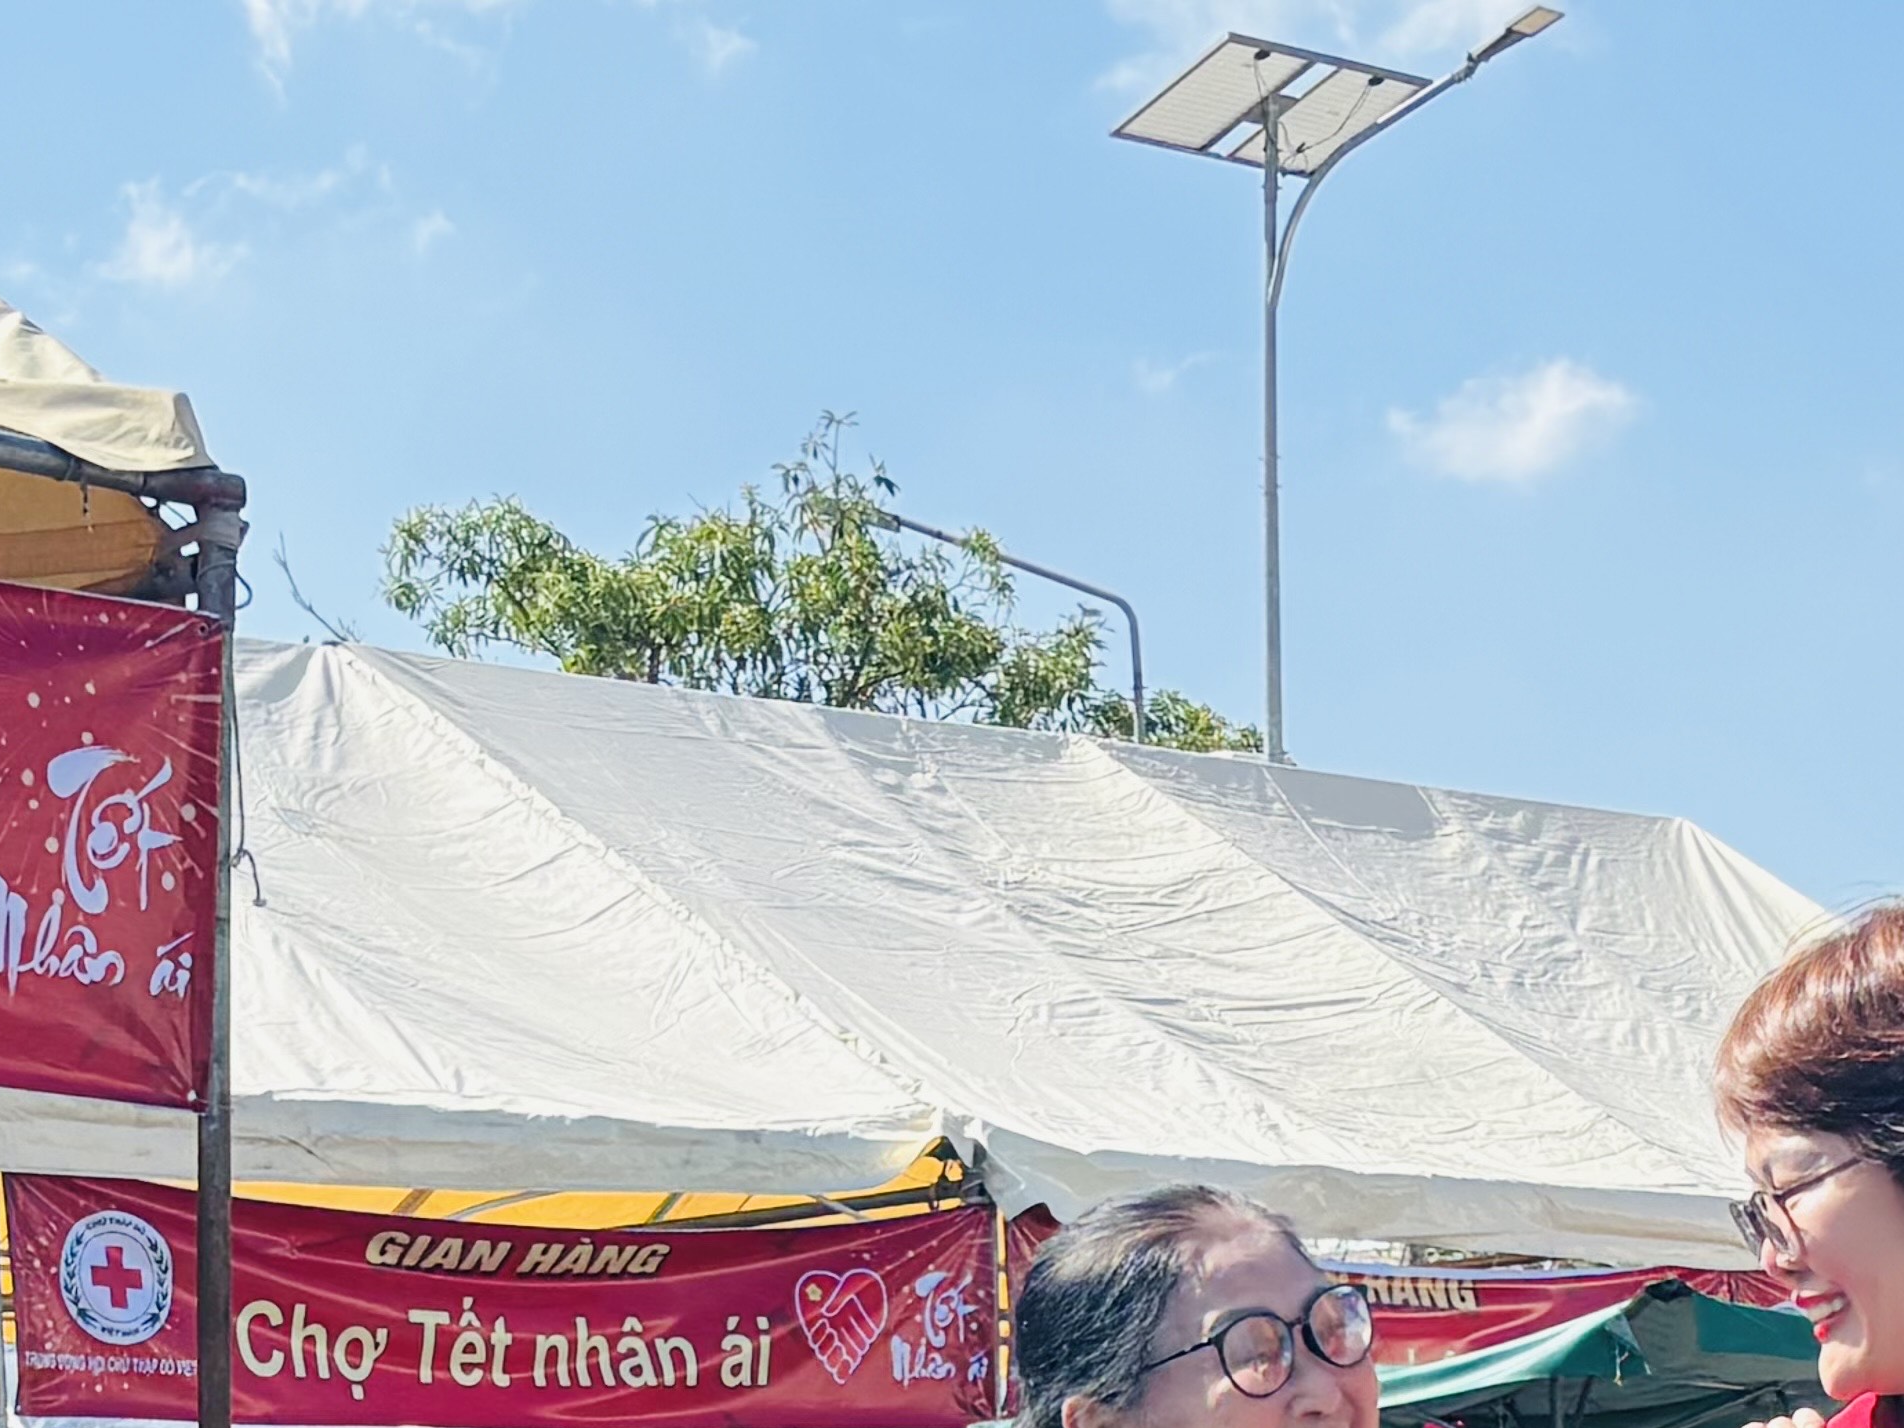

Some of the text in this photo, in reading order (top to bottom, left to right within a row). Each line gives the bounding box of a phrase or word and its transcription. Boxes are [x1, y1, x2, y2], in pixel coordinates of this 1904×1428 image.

[46, 745, 181, 914] Tết
[364, 1231, 670, 1275] GIAN HÀNG
[236, 1296, 769, 1400] Chợ Tết nhân ái
